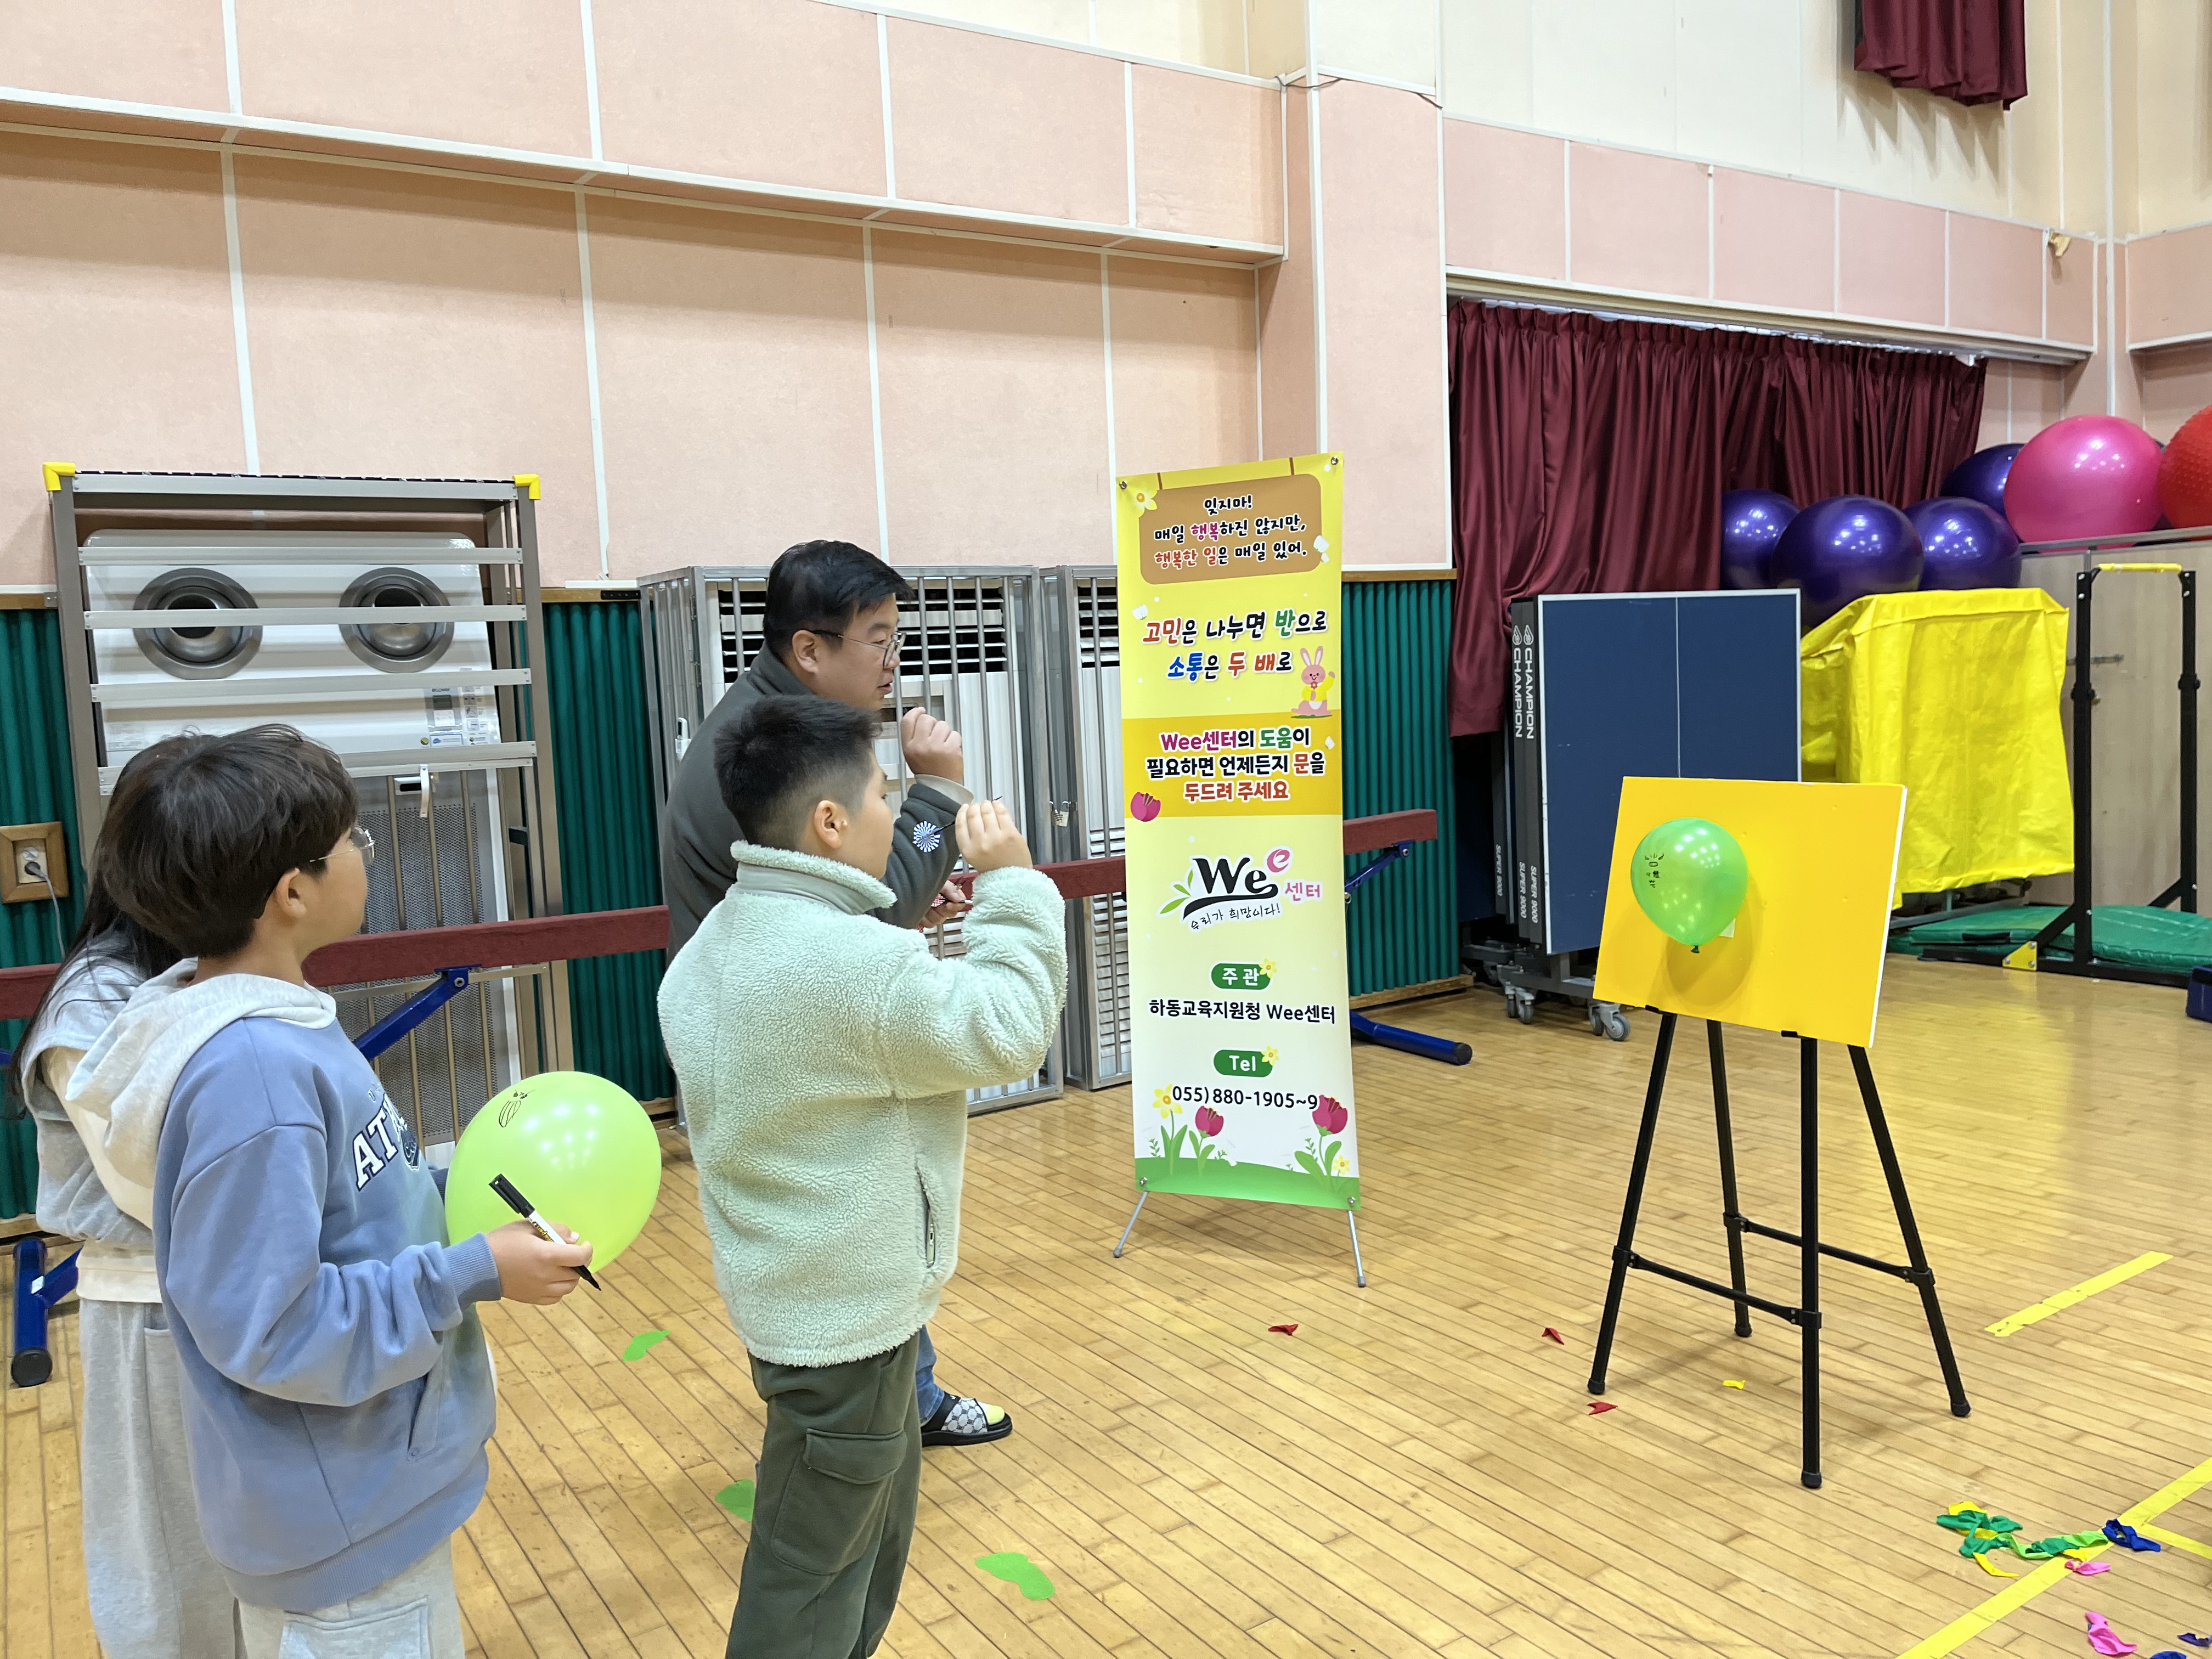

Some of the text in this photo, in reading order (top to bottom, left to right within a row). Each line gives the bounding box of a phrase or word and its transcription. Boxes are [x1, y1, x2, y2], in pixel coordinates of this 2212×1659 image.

[1204, 496, 1252, 515] 잊지마!
[1155, 515, 1306, 543] 매일 행복하진 않지만,
[1155, 541, 1306, 568] 행복한 일은 매일 있어.
[1143, 610, 1327, 645] 고민은 나누면 반으로
[1168, 652, 1292, 681] 소통은 두 배로
[1514, 647, 1522, 737] CHAMPION
[1525, 647, 1534, 739] CHAMPION
[1161, 727, 1310, 751] Wee센터의 도움이
[1147, 752, 1324, 778] 필요하면 언제든지 문을
[1184, 781, 1288, 802] 두드려 주세요
[1285, 883, 1321, 901] 센터
[1191, 904, 1280, 930] 우리가 희망이다!
[1149, 999, 1335, 1024] 하동교육지원청 Wee센터
[1229, 1055, 1256, 1071] Tel
